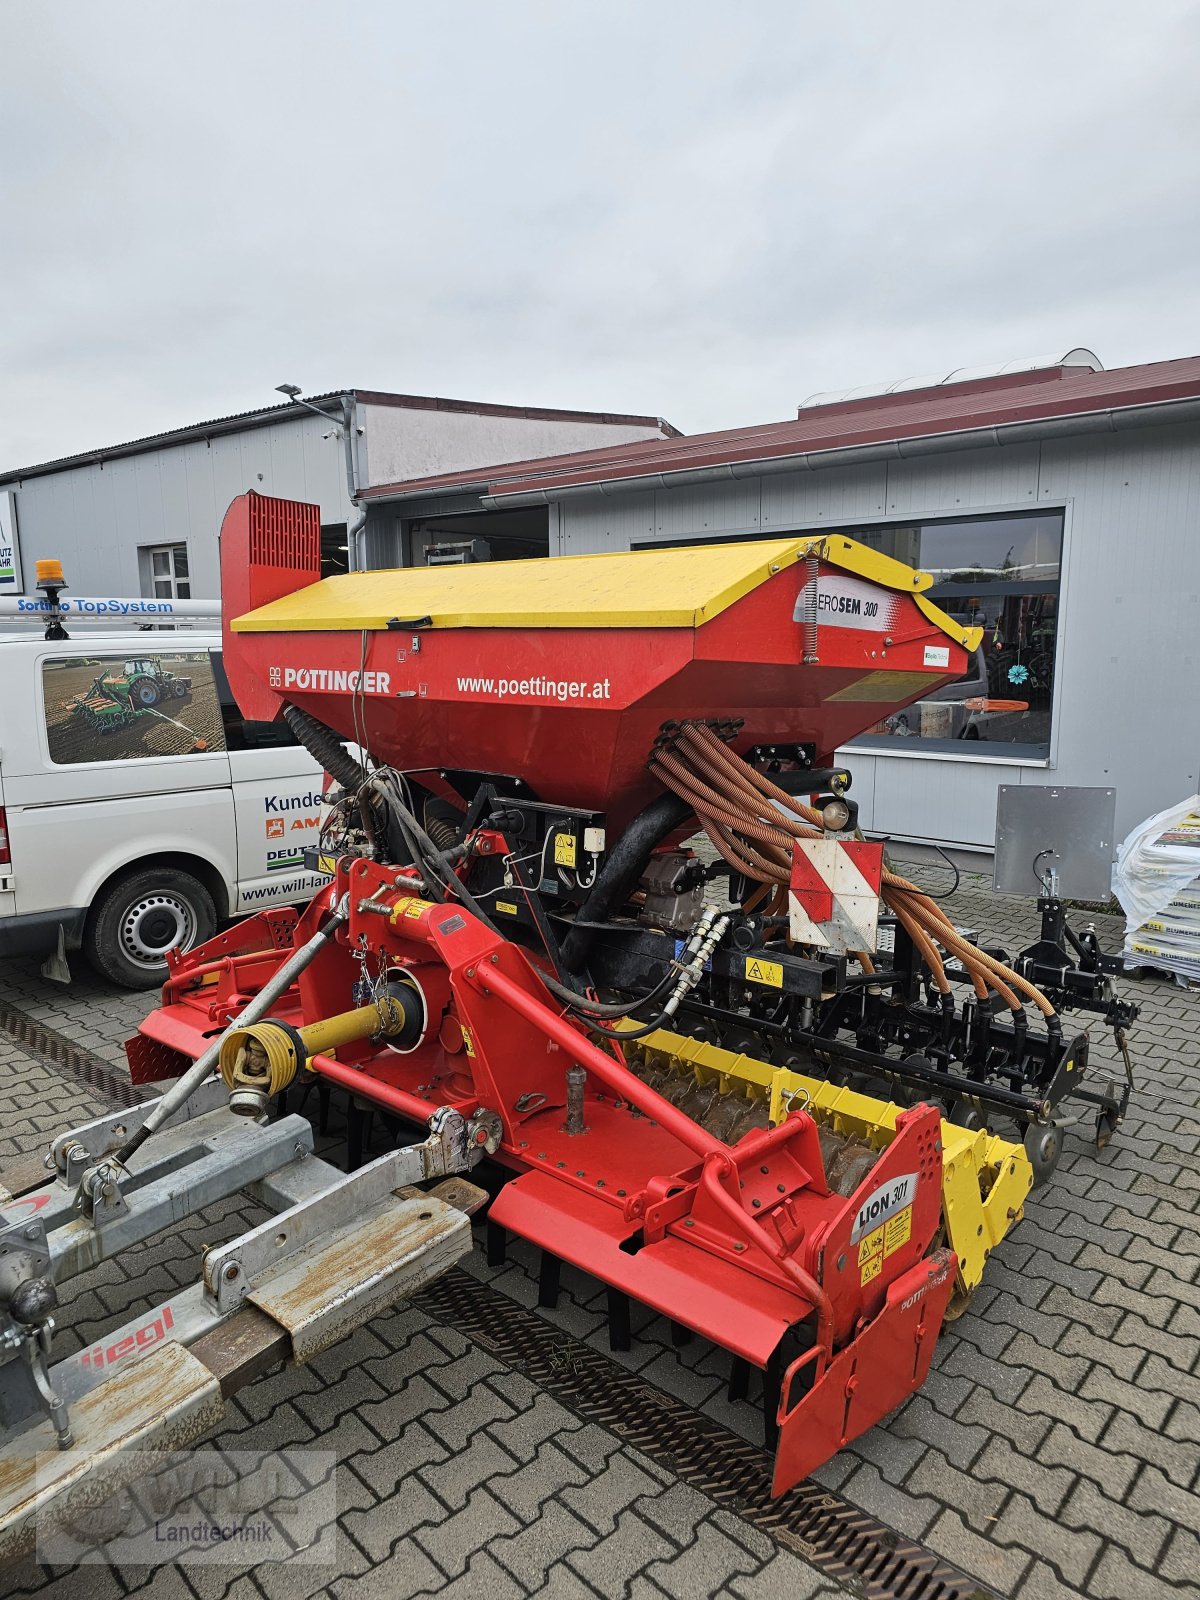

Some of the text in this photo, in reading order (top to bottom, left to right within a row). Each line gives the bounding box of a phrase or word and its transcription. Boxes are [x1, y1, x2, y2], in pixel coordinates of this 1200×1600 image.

[18, 599, 173, 614] Sortio TopSystem
[863, 601, 879, 617] 300
[457, 676, 611, 701] www.poettinger.at
[859, 1179, 909, 1228] LION 301
